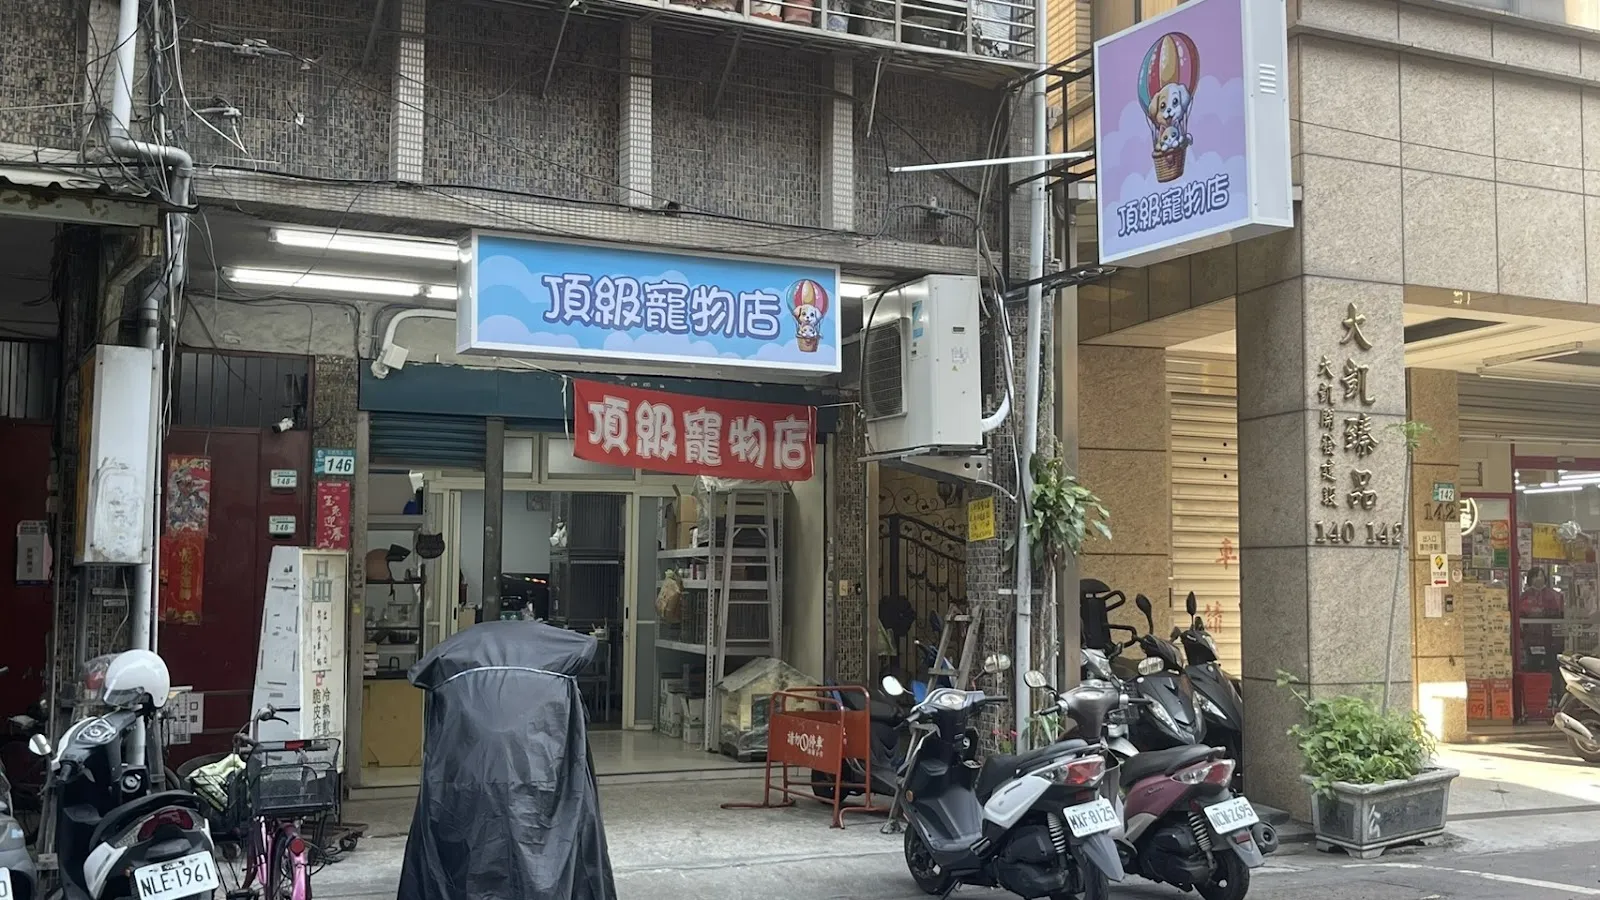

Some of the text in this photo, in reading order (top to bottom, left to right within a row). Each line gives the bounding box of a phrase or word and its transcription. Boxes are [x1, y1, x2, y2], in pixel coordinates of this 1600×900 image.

[1117, 173, 1230, 238] 頂級寵物店
[541, 272, 781, 340] 頂級寵物店
[1339, 302, 1379, 511] 大凱臻品
[587, 394, 808, 470] 頂級寵物店
[327, 458, 353, 473] 146
[1440, 488, 1454, 500] 142
[1424, 503, 1457, 521] 142
[1315, 519, 1402, 545] 140 142
[1215, 538, 1237, 571] 車
[1068, 805, 1115, 830] MXF-8125
[1209, 803, 1254, 829] NCW-2695
[140, 862, 212, 897] NLE-1961
